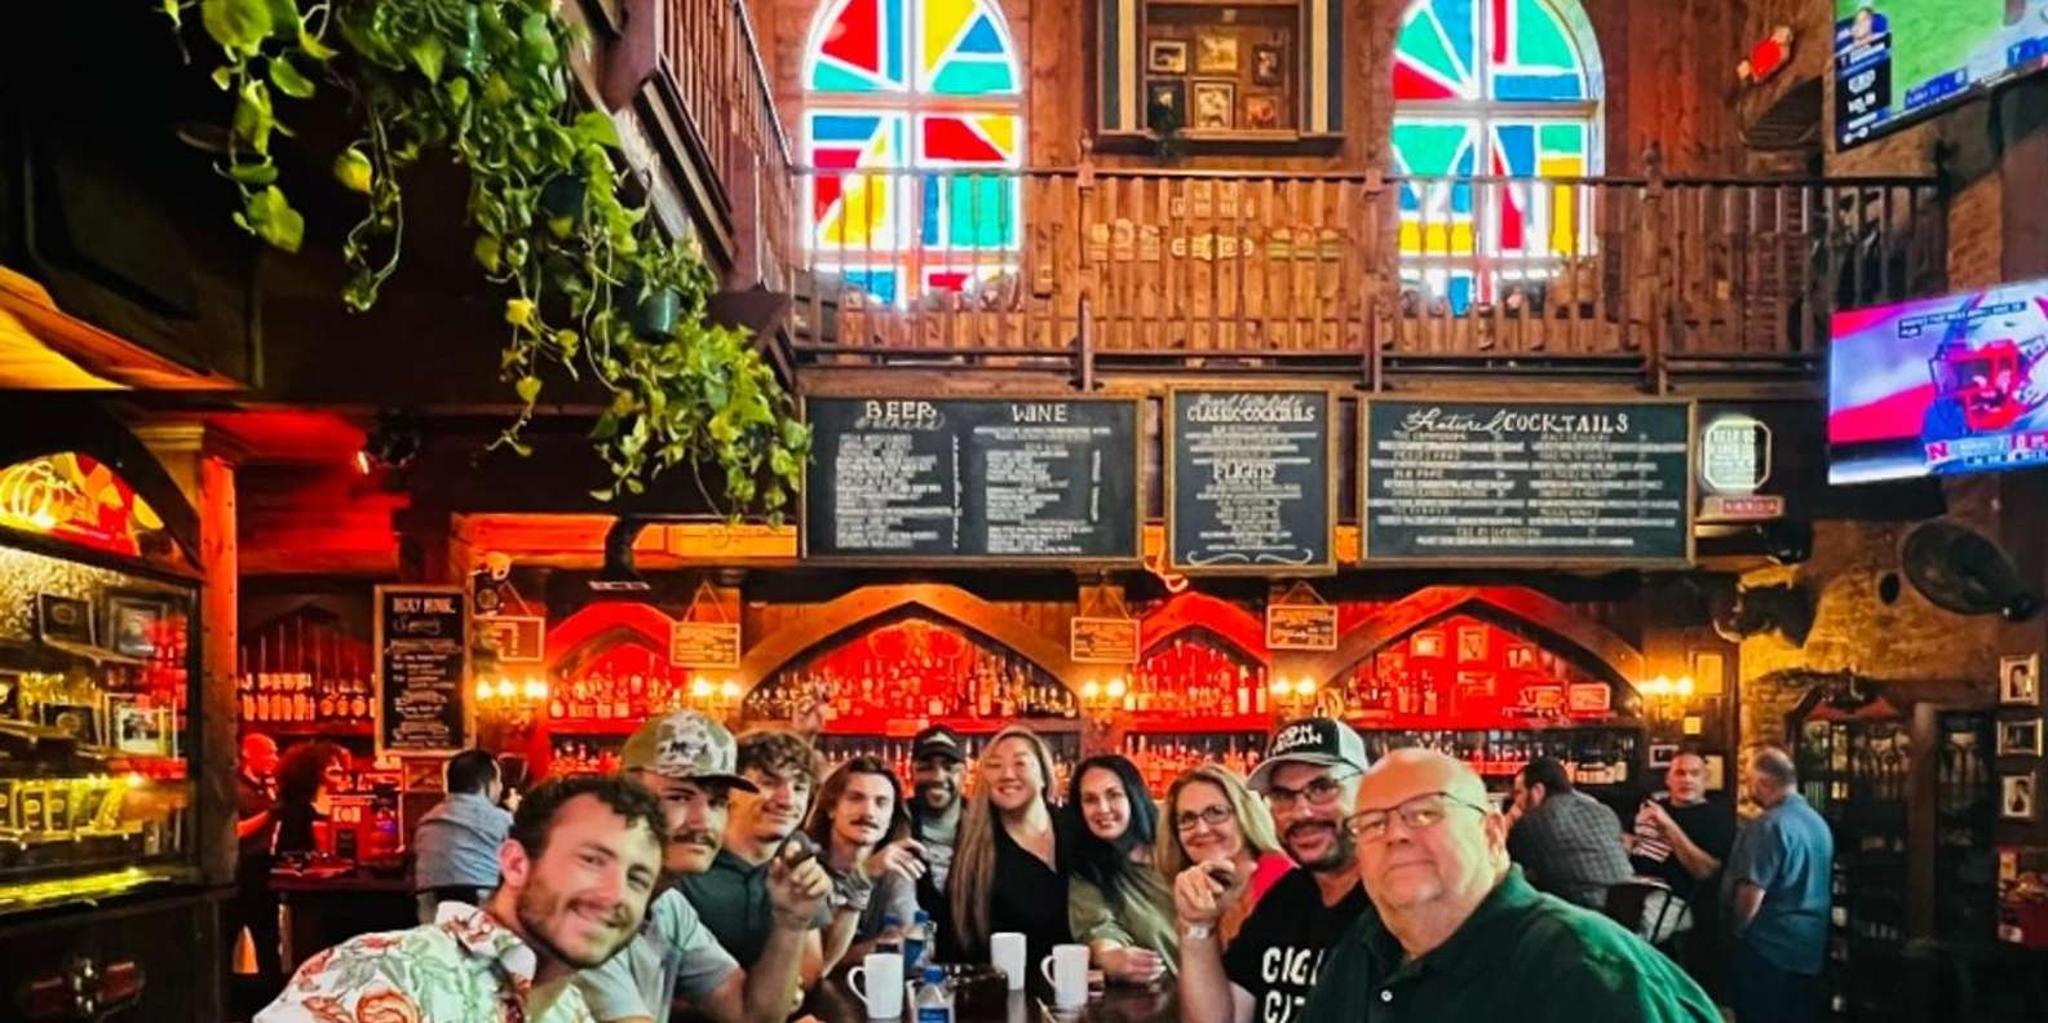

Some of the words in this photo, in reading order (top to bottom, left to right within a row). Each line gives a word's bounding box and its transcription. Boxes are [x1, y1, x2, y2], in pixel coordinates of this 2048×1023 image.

[866, 401, 937, 420] BEER
[1012, 404, 1068, 422] WINE
[1187, 406, 1241, 422] CLASSIC
[1243, 406, 1316, 422] COCKTAILS
[1504, 411, 1629, 433] COCKTAILS
